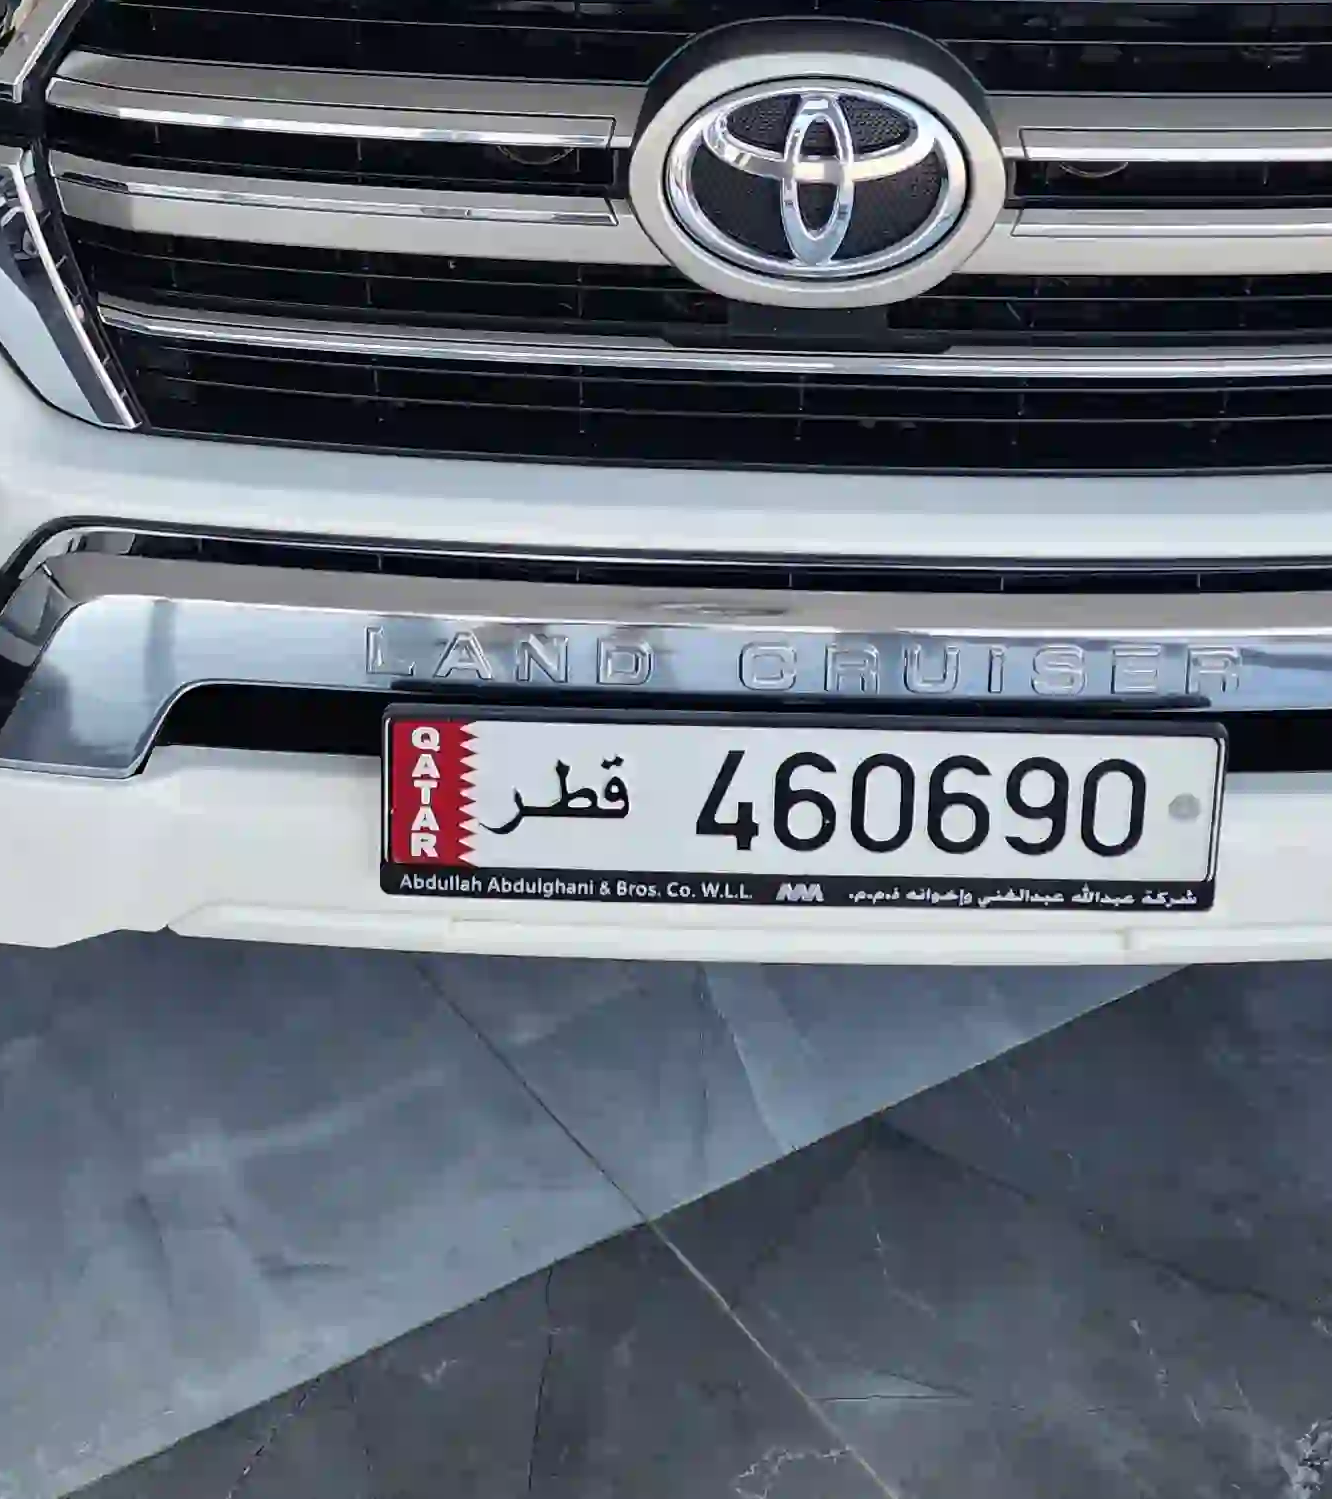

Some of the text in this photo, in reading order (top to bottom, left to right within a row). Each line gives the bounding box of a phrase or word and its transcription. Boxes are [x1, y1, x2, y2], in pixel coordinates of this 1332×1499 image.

[365, 625, 1242, 696] LAND CRUISER
[410, 725, 441, 859] QATAR
[478, 749, 1146, 857] قطر 460690
[400, 874, 753, 900] Abdullah Abdulghani & Bros. Co. W.L.L.
[1141, 888, 1198, 908] شركة
